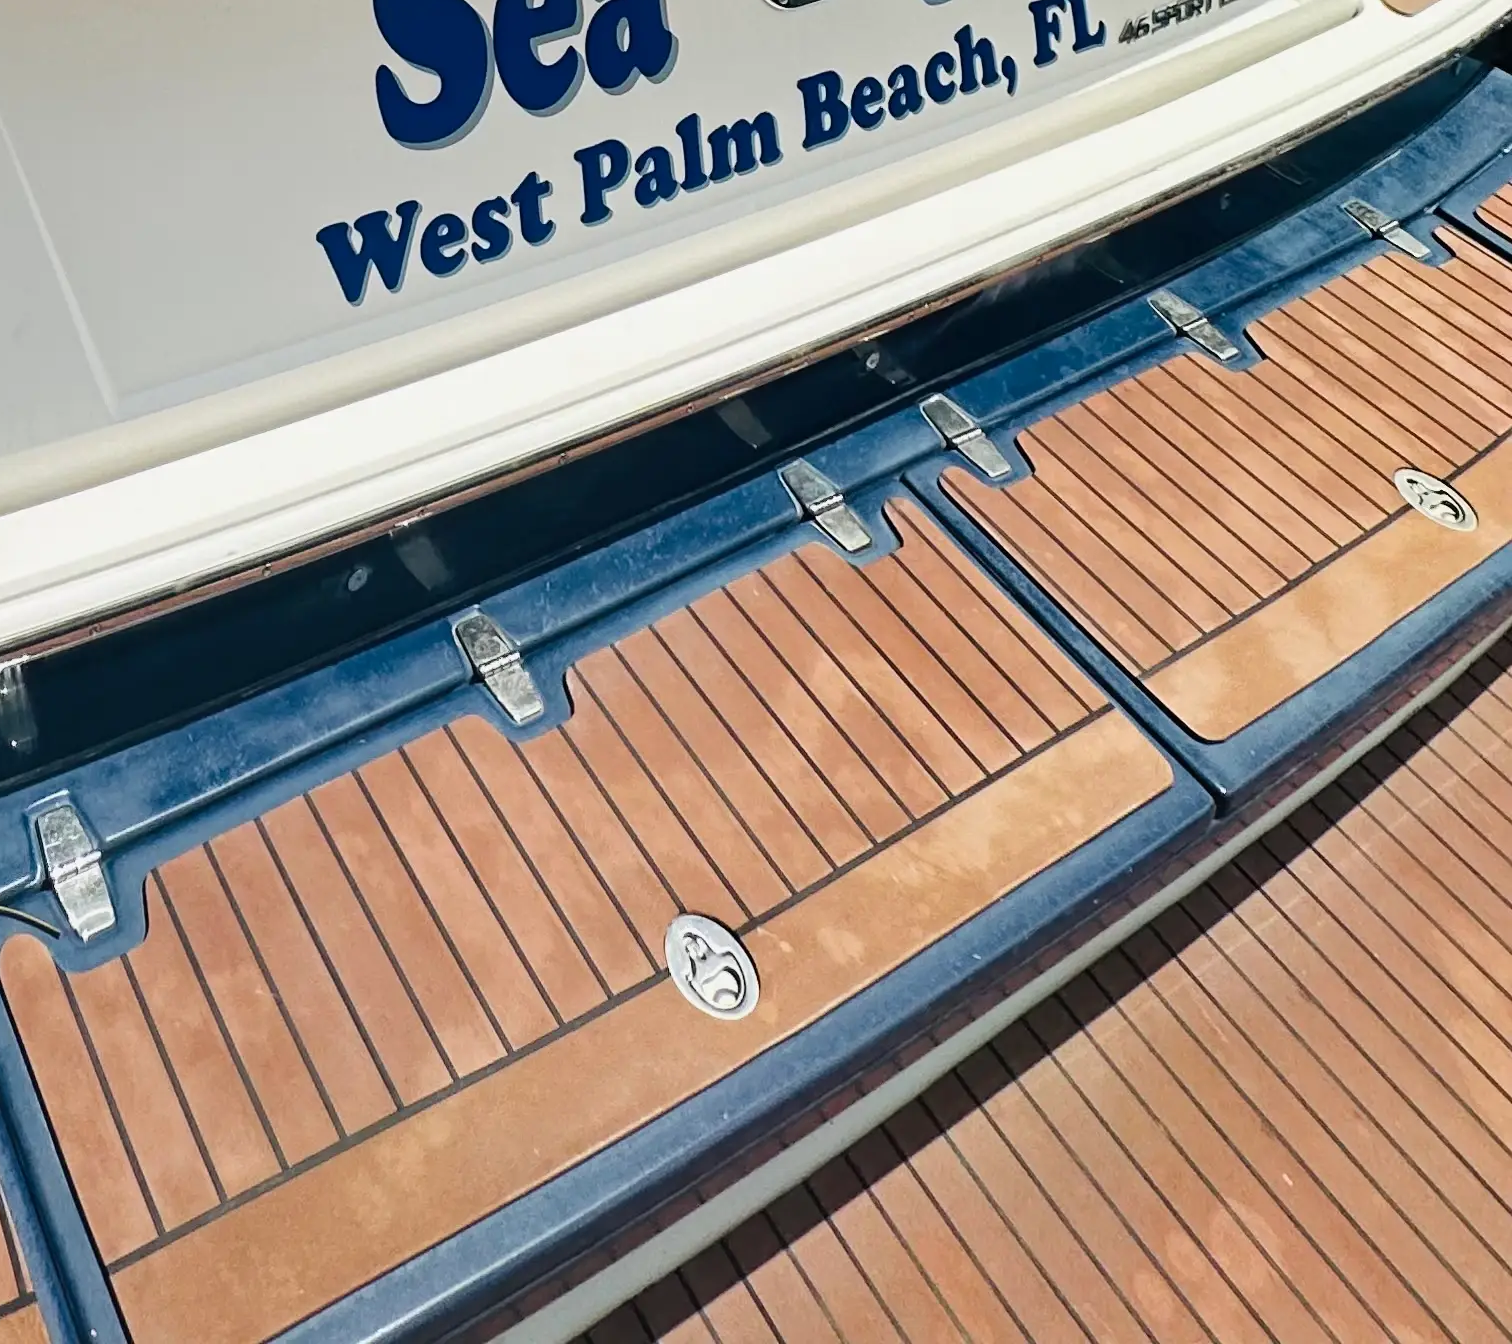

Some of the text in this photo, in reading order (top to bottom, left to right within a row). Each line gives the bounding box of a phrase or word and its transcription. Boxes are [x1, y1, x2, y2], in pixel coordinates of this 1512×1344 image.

[1118, 13, 1150, 44] 46
[316, 171, 556, 307] West
[574, 111, 784, 227] Palm
[797, 23, 1019, 151] Beach,
